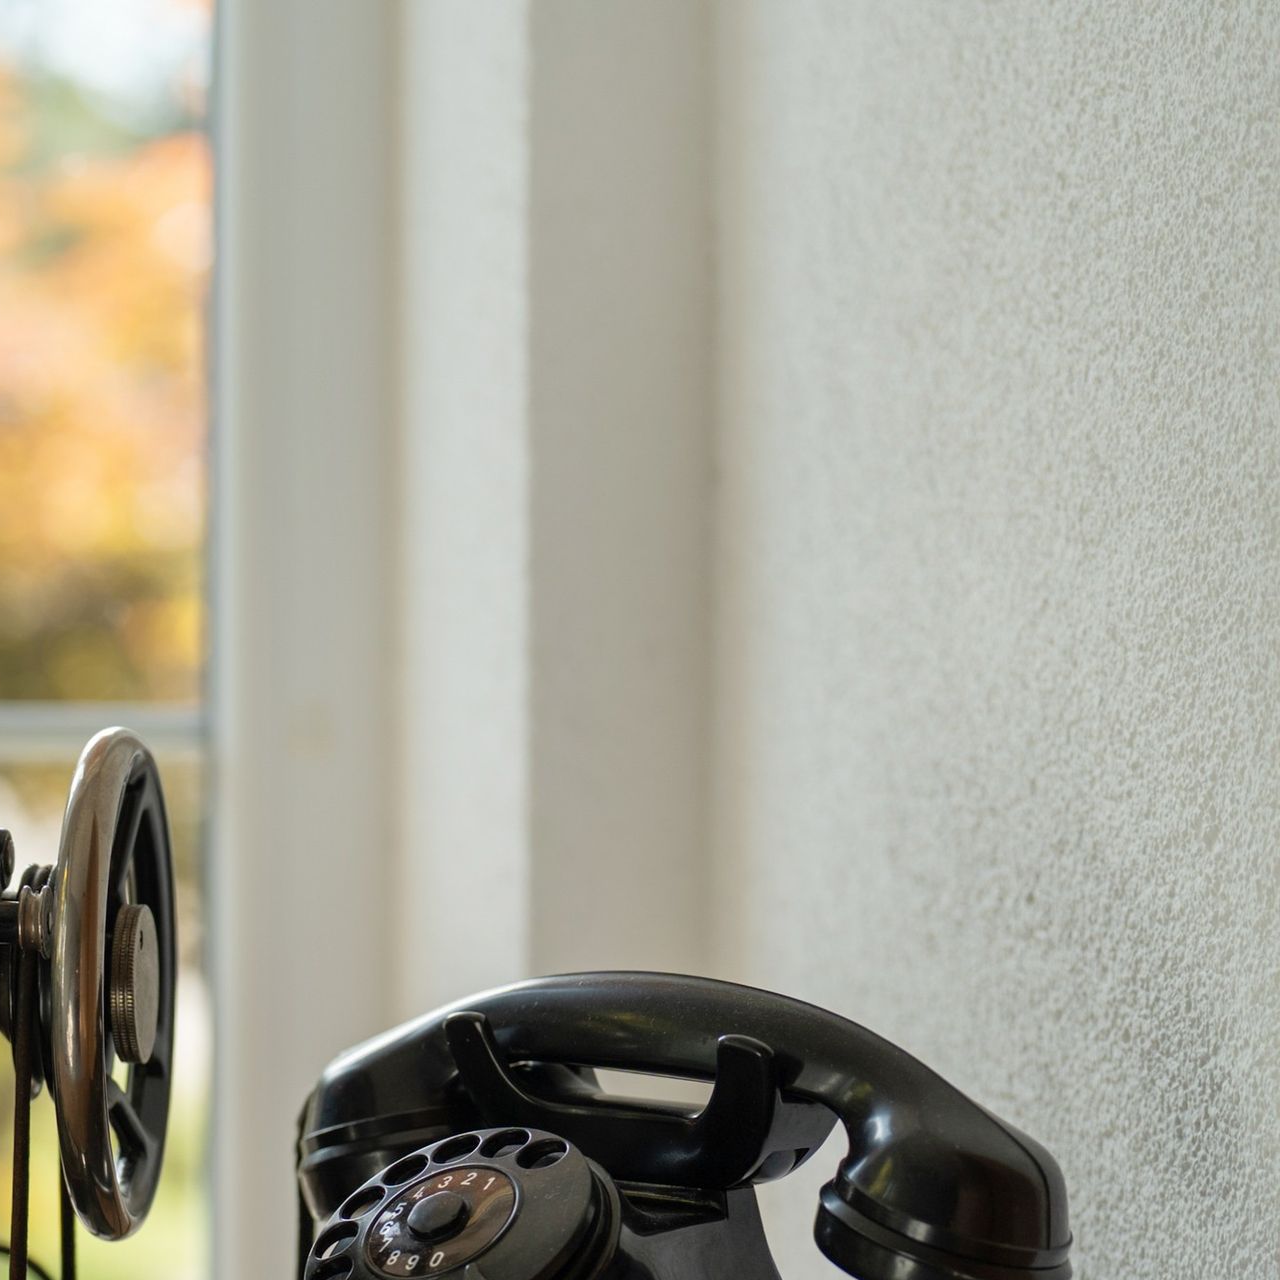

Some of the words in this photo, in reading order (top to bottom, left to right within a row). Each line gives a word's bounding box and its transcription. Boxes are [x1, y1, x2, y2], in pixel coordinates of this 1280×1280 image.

[438, 1176, 453, 1188] 3
[461, 1172, 477, 1185] 2
[483, 1177, 496, 1191] 1
[412, 1186, 425, 1200] 4
[391, 1202, 407, 1219] 5
[379, 1220, 394, 1236] 6
[379, 1237, 393, 1253] 7
[386, 1250, 401, 1266] 8
[405, 1255, 420, 1271] 9
[429, 1251, 445, 1268] 0
